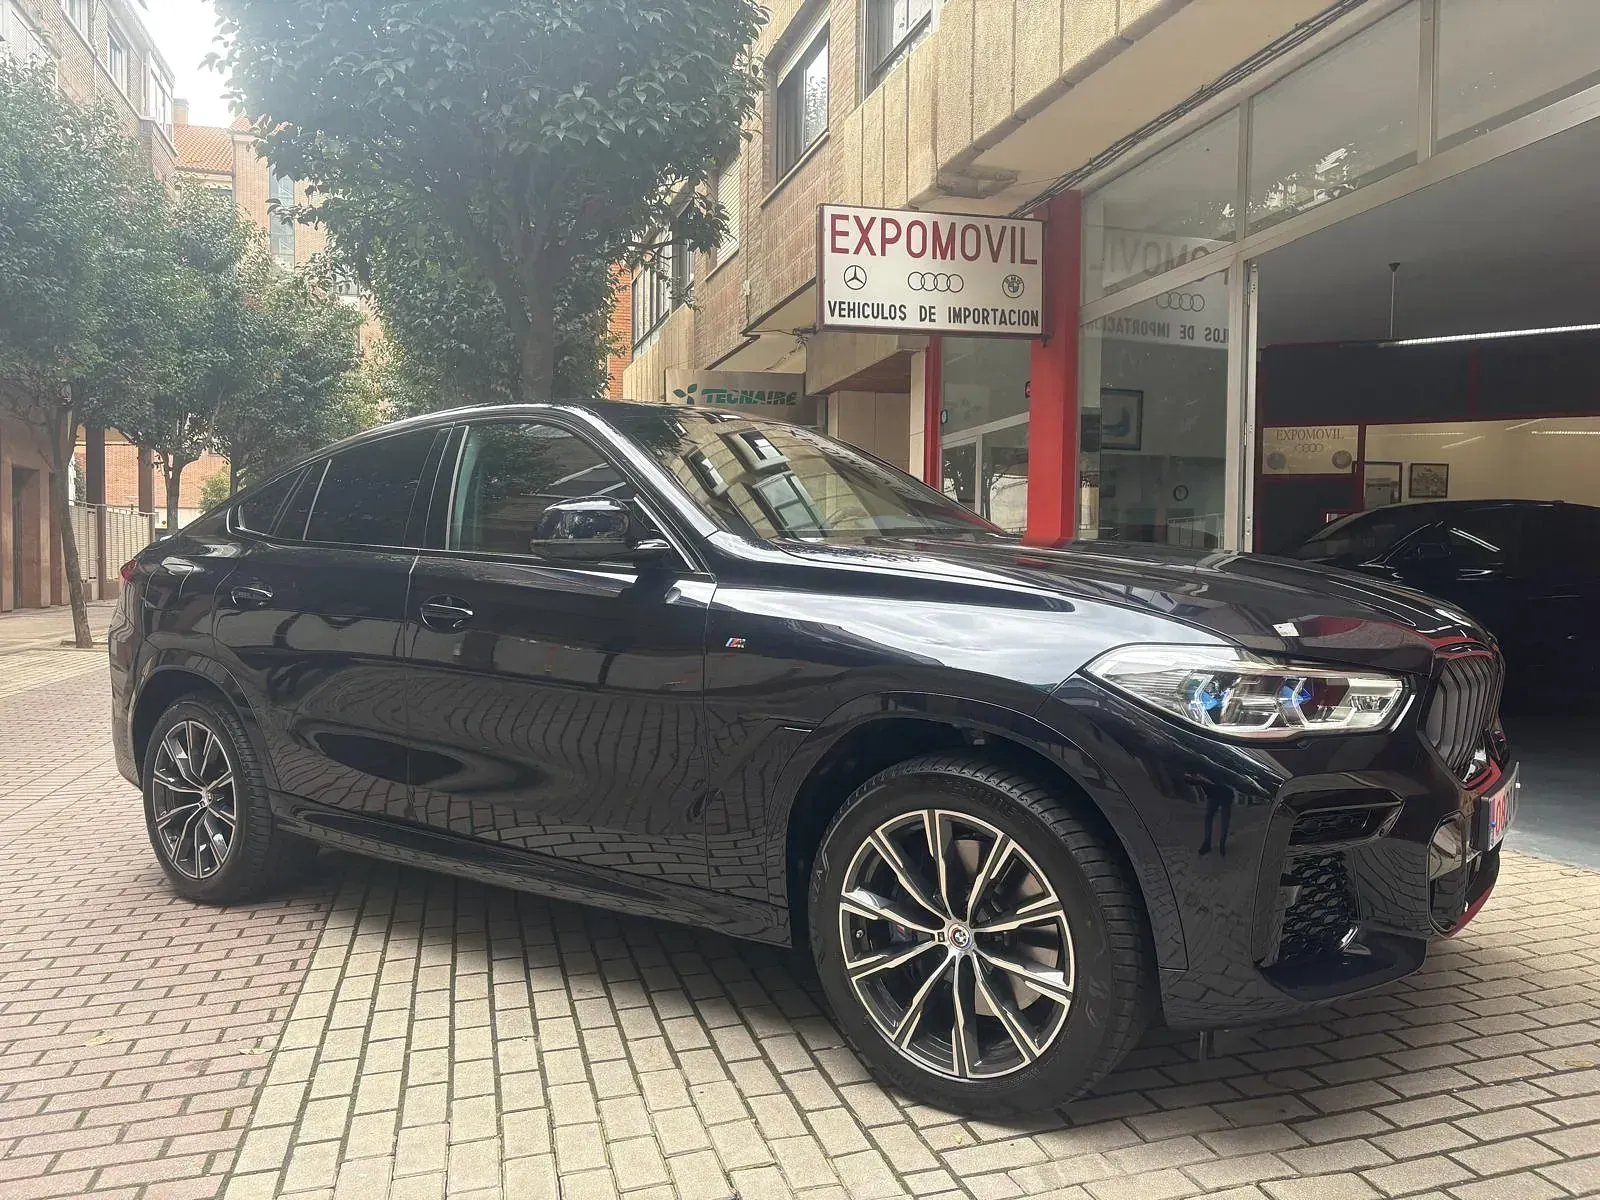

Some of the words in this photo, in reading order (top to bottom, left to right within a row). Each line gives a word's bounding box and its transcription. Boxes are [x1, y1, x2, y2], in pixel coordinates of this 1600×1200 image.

[830, 213, 1038, 265] EXPOMOVIL
[827, 300, 907, 321] VEHICULOS
[919, 305, 937, 323] DE
[948, 306, 1040, 327] IMPORTACION
[701, 388, 798, 406] TECNAIRE
[1276, 428, 1344, 441] EXPOMOVIL
